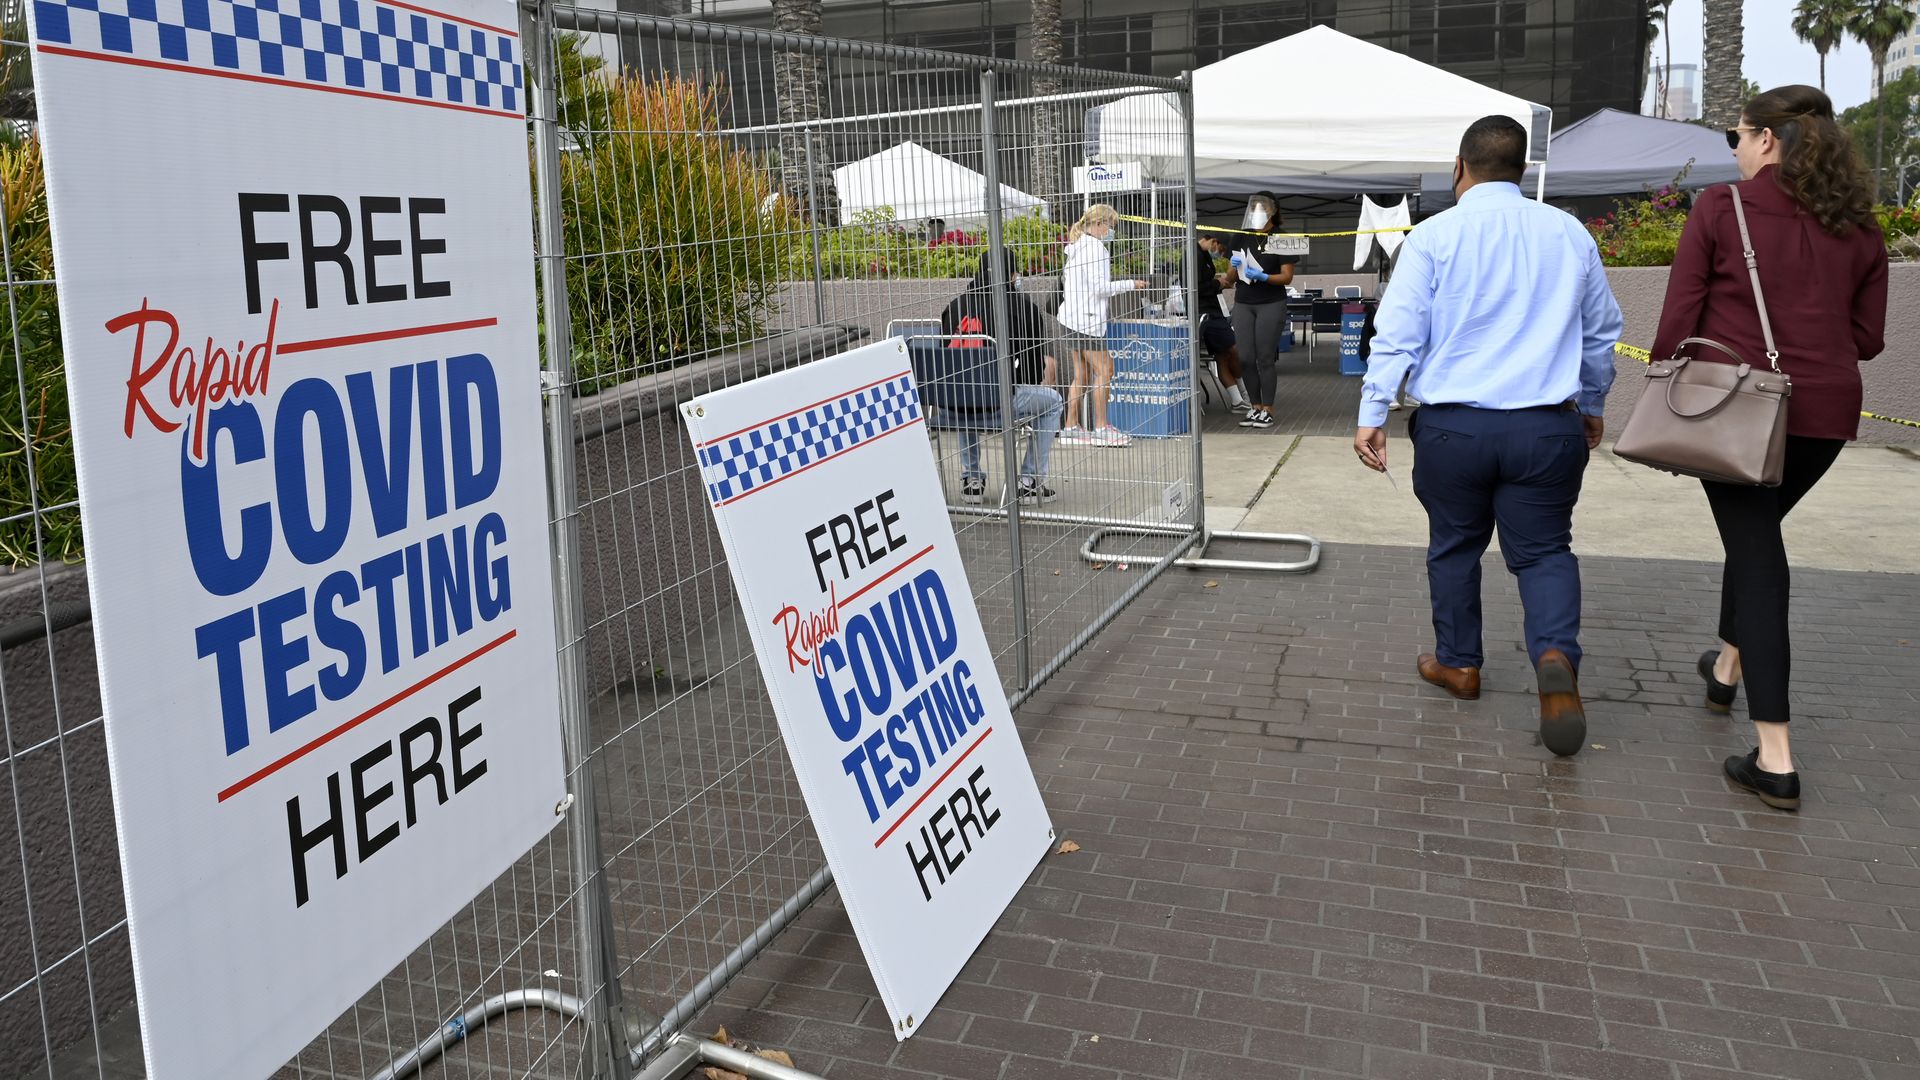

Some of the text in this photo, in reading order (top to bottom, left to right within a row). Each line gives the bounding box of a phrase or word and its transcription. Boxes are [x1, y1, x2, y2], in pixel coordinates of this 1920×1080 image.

[1091, 171, 1123, 181] United
[238, 193, 451, 314] FREE
[1268, 237, 1308, 250] RESULTS
[105, 297, 279, 460] Rapid
[1108, 348, 1163, 362] pecright
[1117, 394, 1168, 404] FASTER
[180, 353, 502, 596] COVID
[805, 488, 907, 593] FREE
[195, 512, 512, 756] TESTING
[772, 580, 840, 675] Rapid
[812, 569, 957, 742] COVID
[286, 685, 488, 909] HERE
[841, 660, 985, 824] TESTING
[905, 764, 1001, 902] HERE
